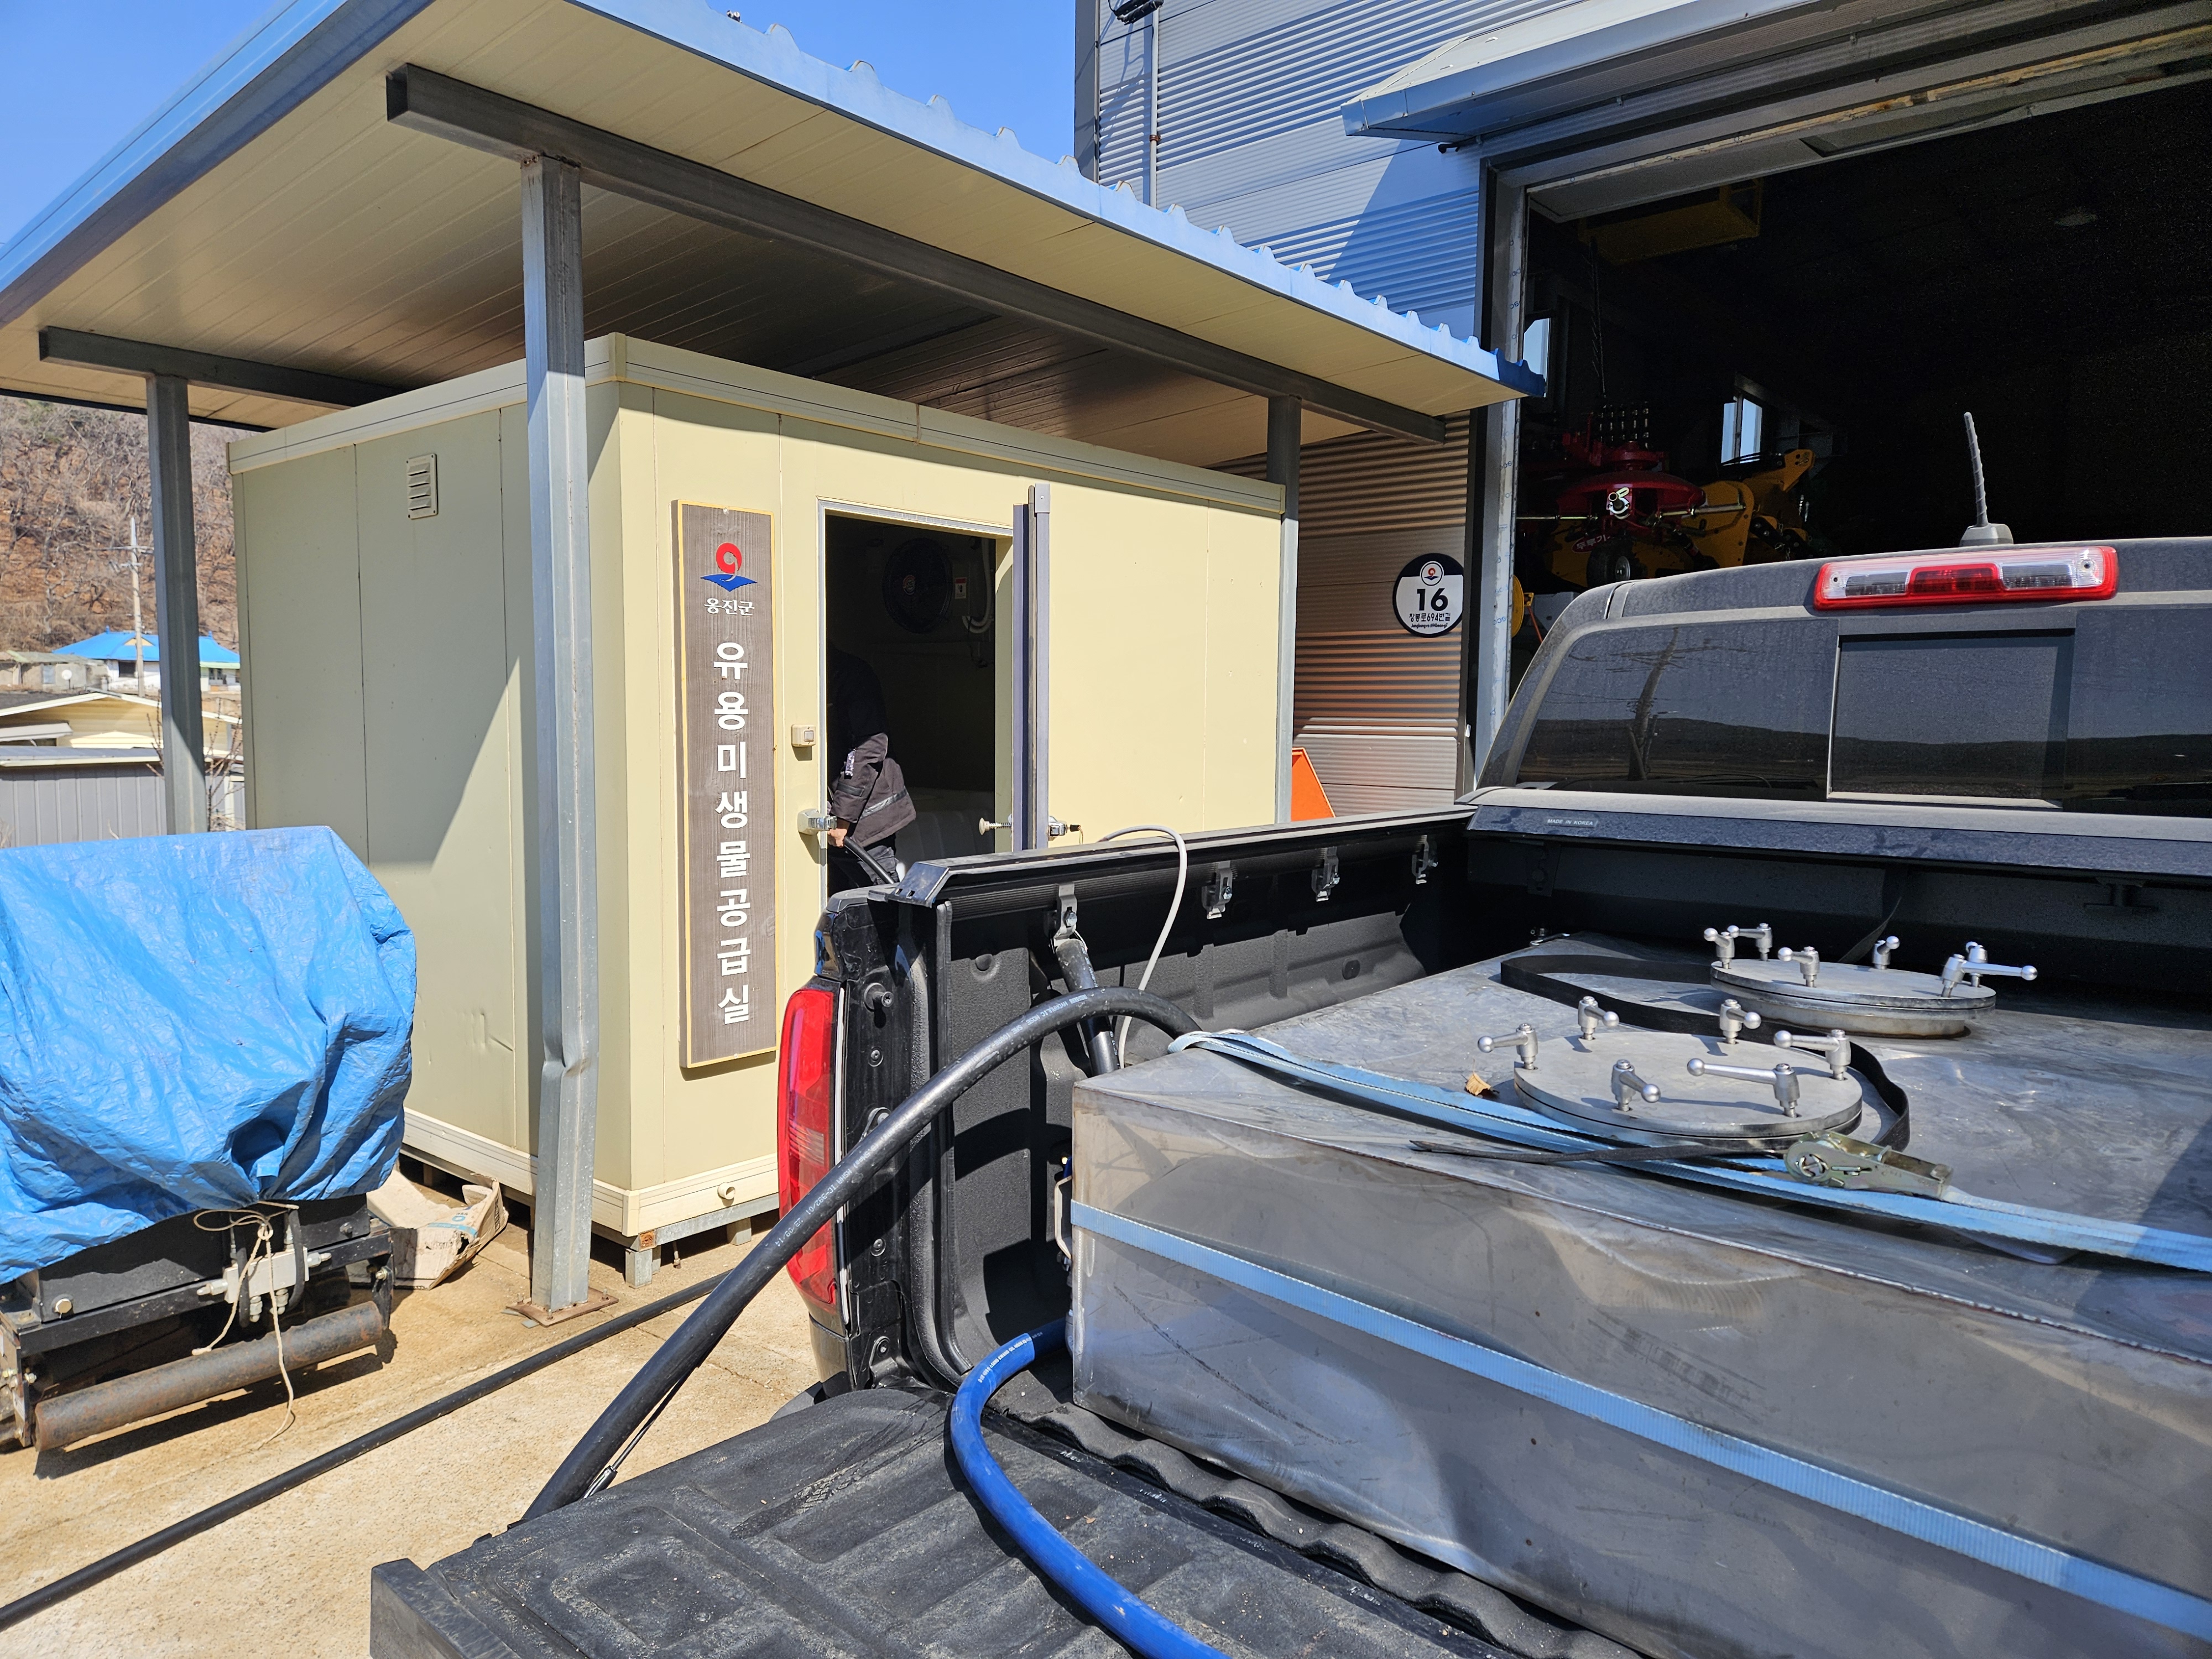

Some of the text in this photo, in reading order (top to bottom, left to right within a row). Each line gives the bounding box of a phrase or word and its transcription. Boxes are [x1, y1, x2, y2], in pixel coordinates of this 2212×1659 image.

[703, 597, 755, 616] 옹진군
[1417, 588, 1448, 611] 16
[1409, 613, 1451, 623] 장봉로694번길
[713, 641, 751, 1025] 유용미생물공급실
[1040, 1000, 1068, 1018] HYDRAULIC
[1025, 1014, 1041, 1026] HOSE
[805, 1183, 837, 1215] IC-392/01
